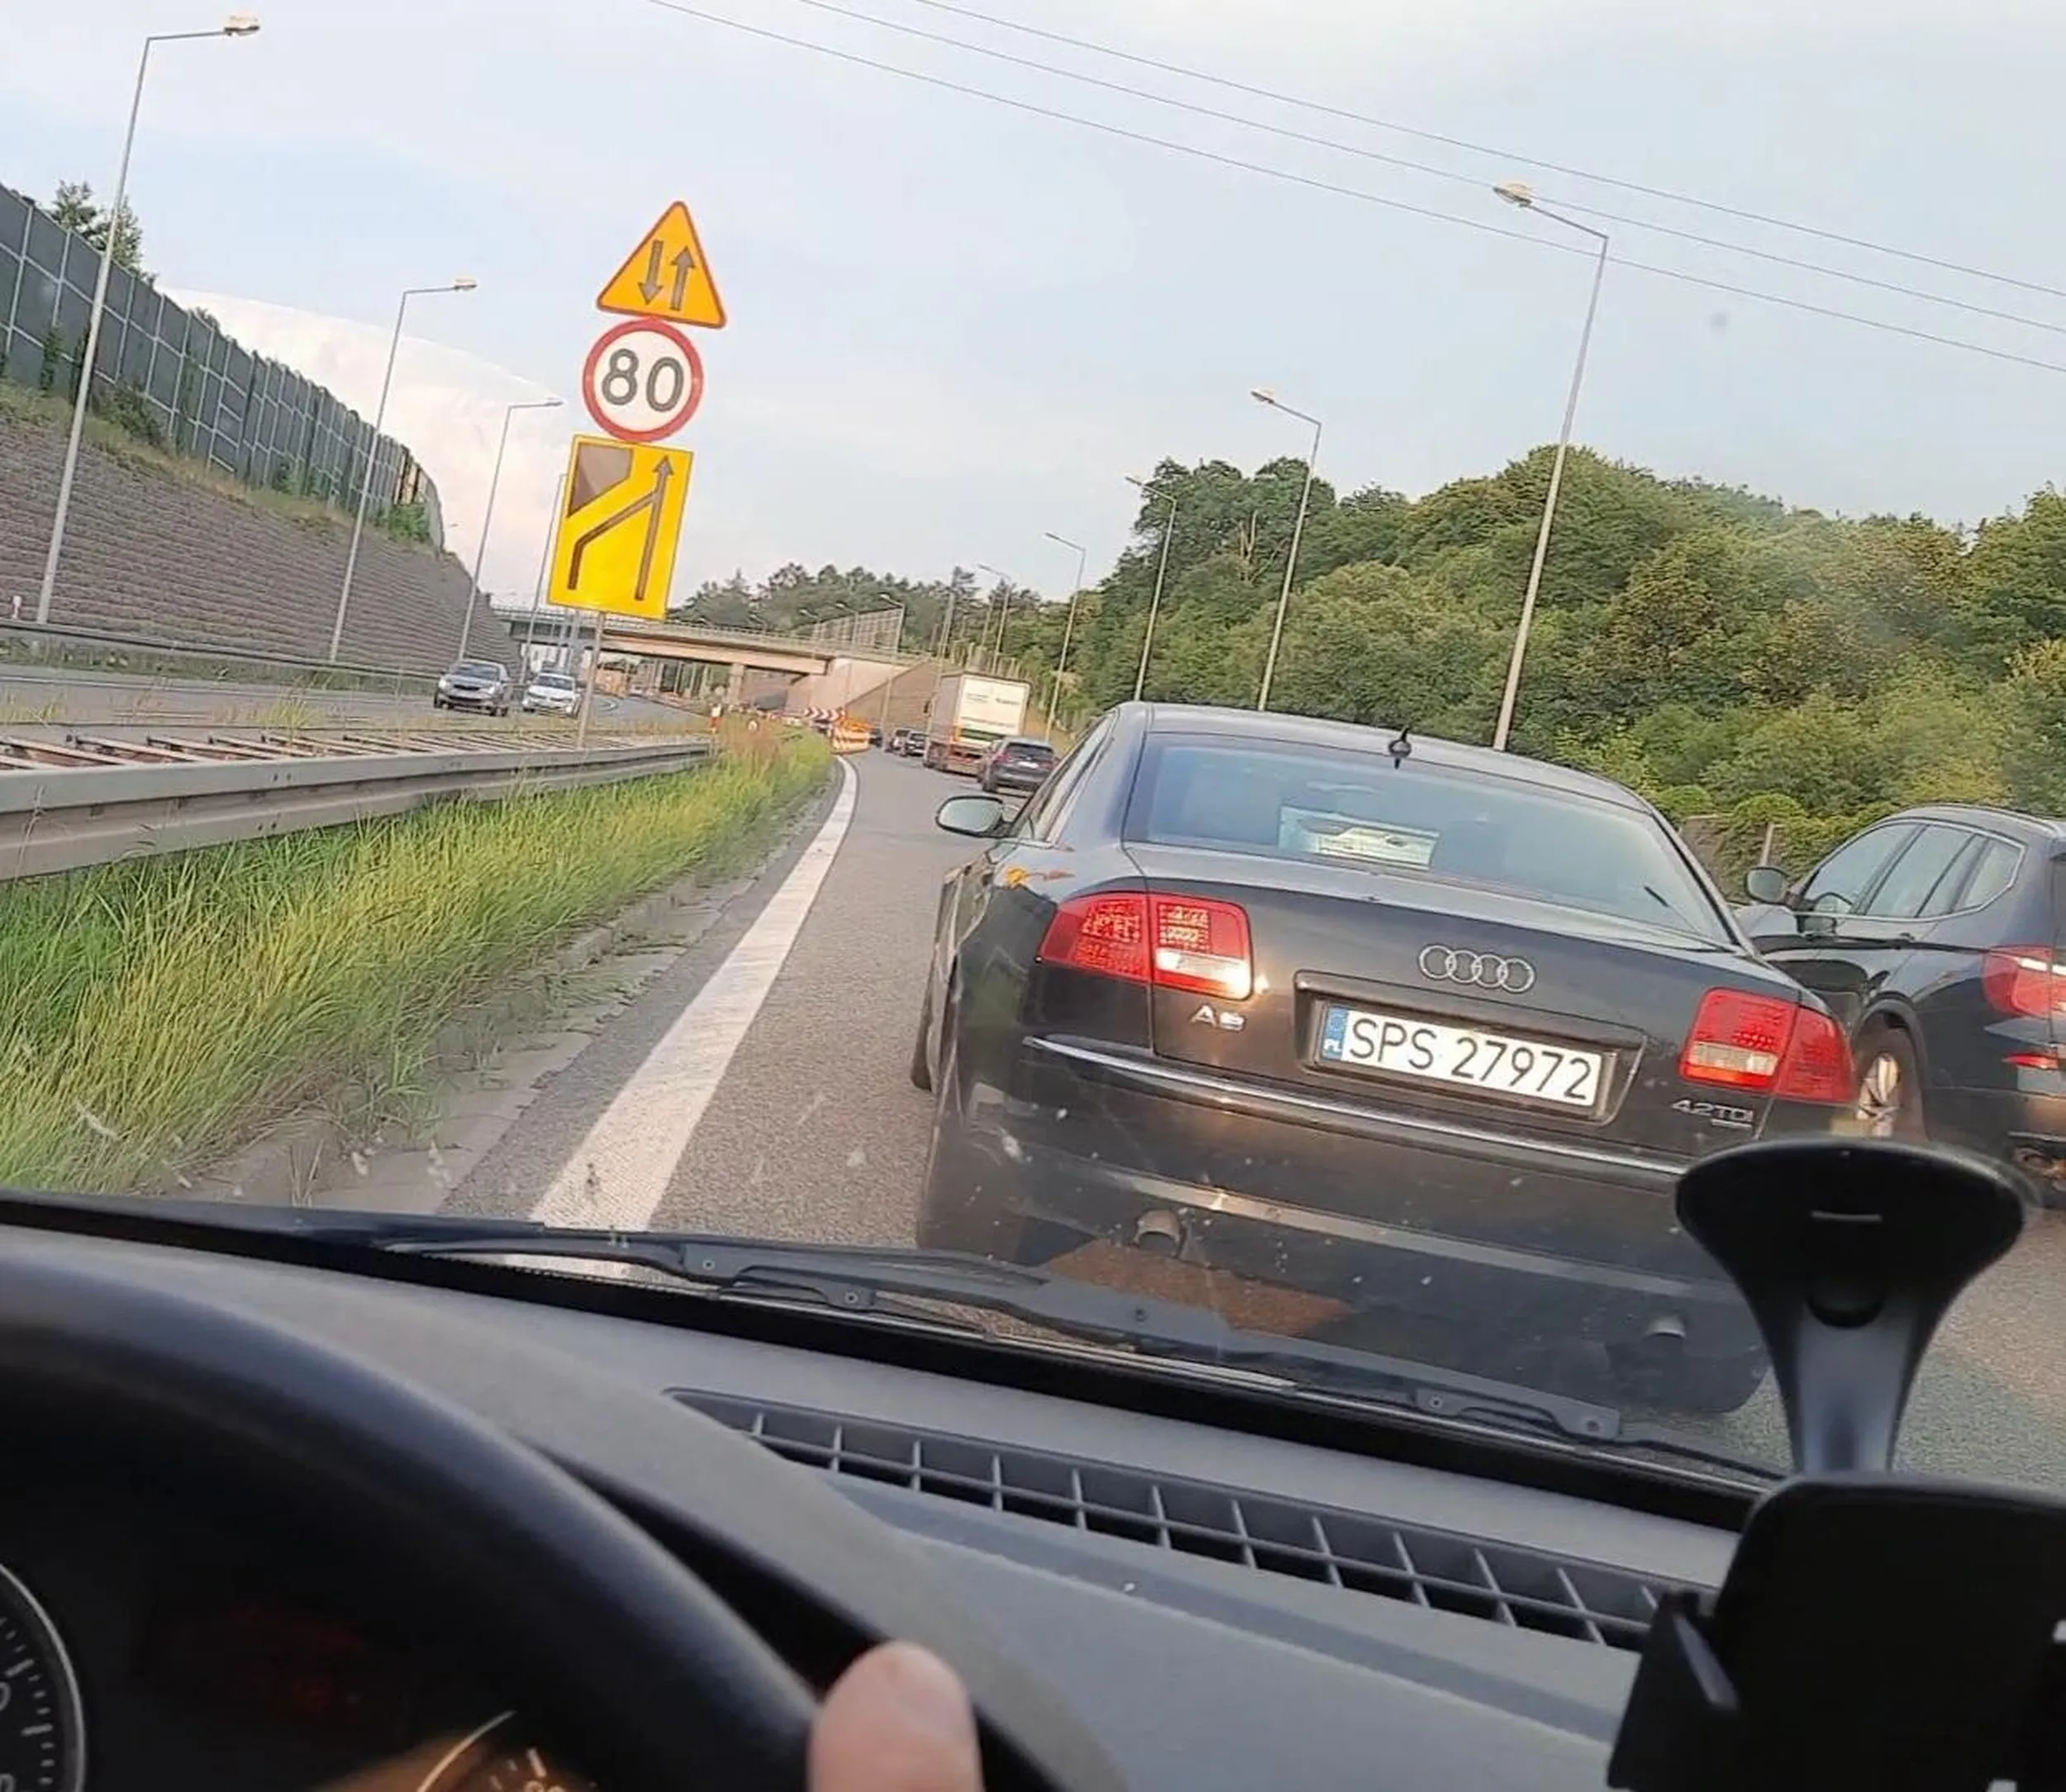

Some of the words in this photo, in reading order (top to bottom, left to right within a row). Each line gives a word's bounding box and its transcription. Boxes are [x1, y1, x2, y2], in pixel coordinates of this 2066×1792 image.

[602, 348, 684, 412] 80
[1350, 1018, 1437, 1070] SPS
[1451, 1037, 1592, 1100] 27972
